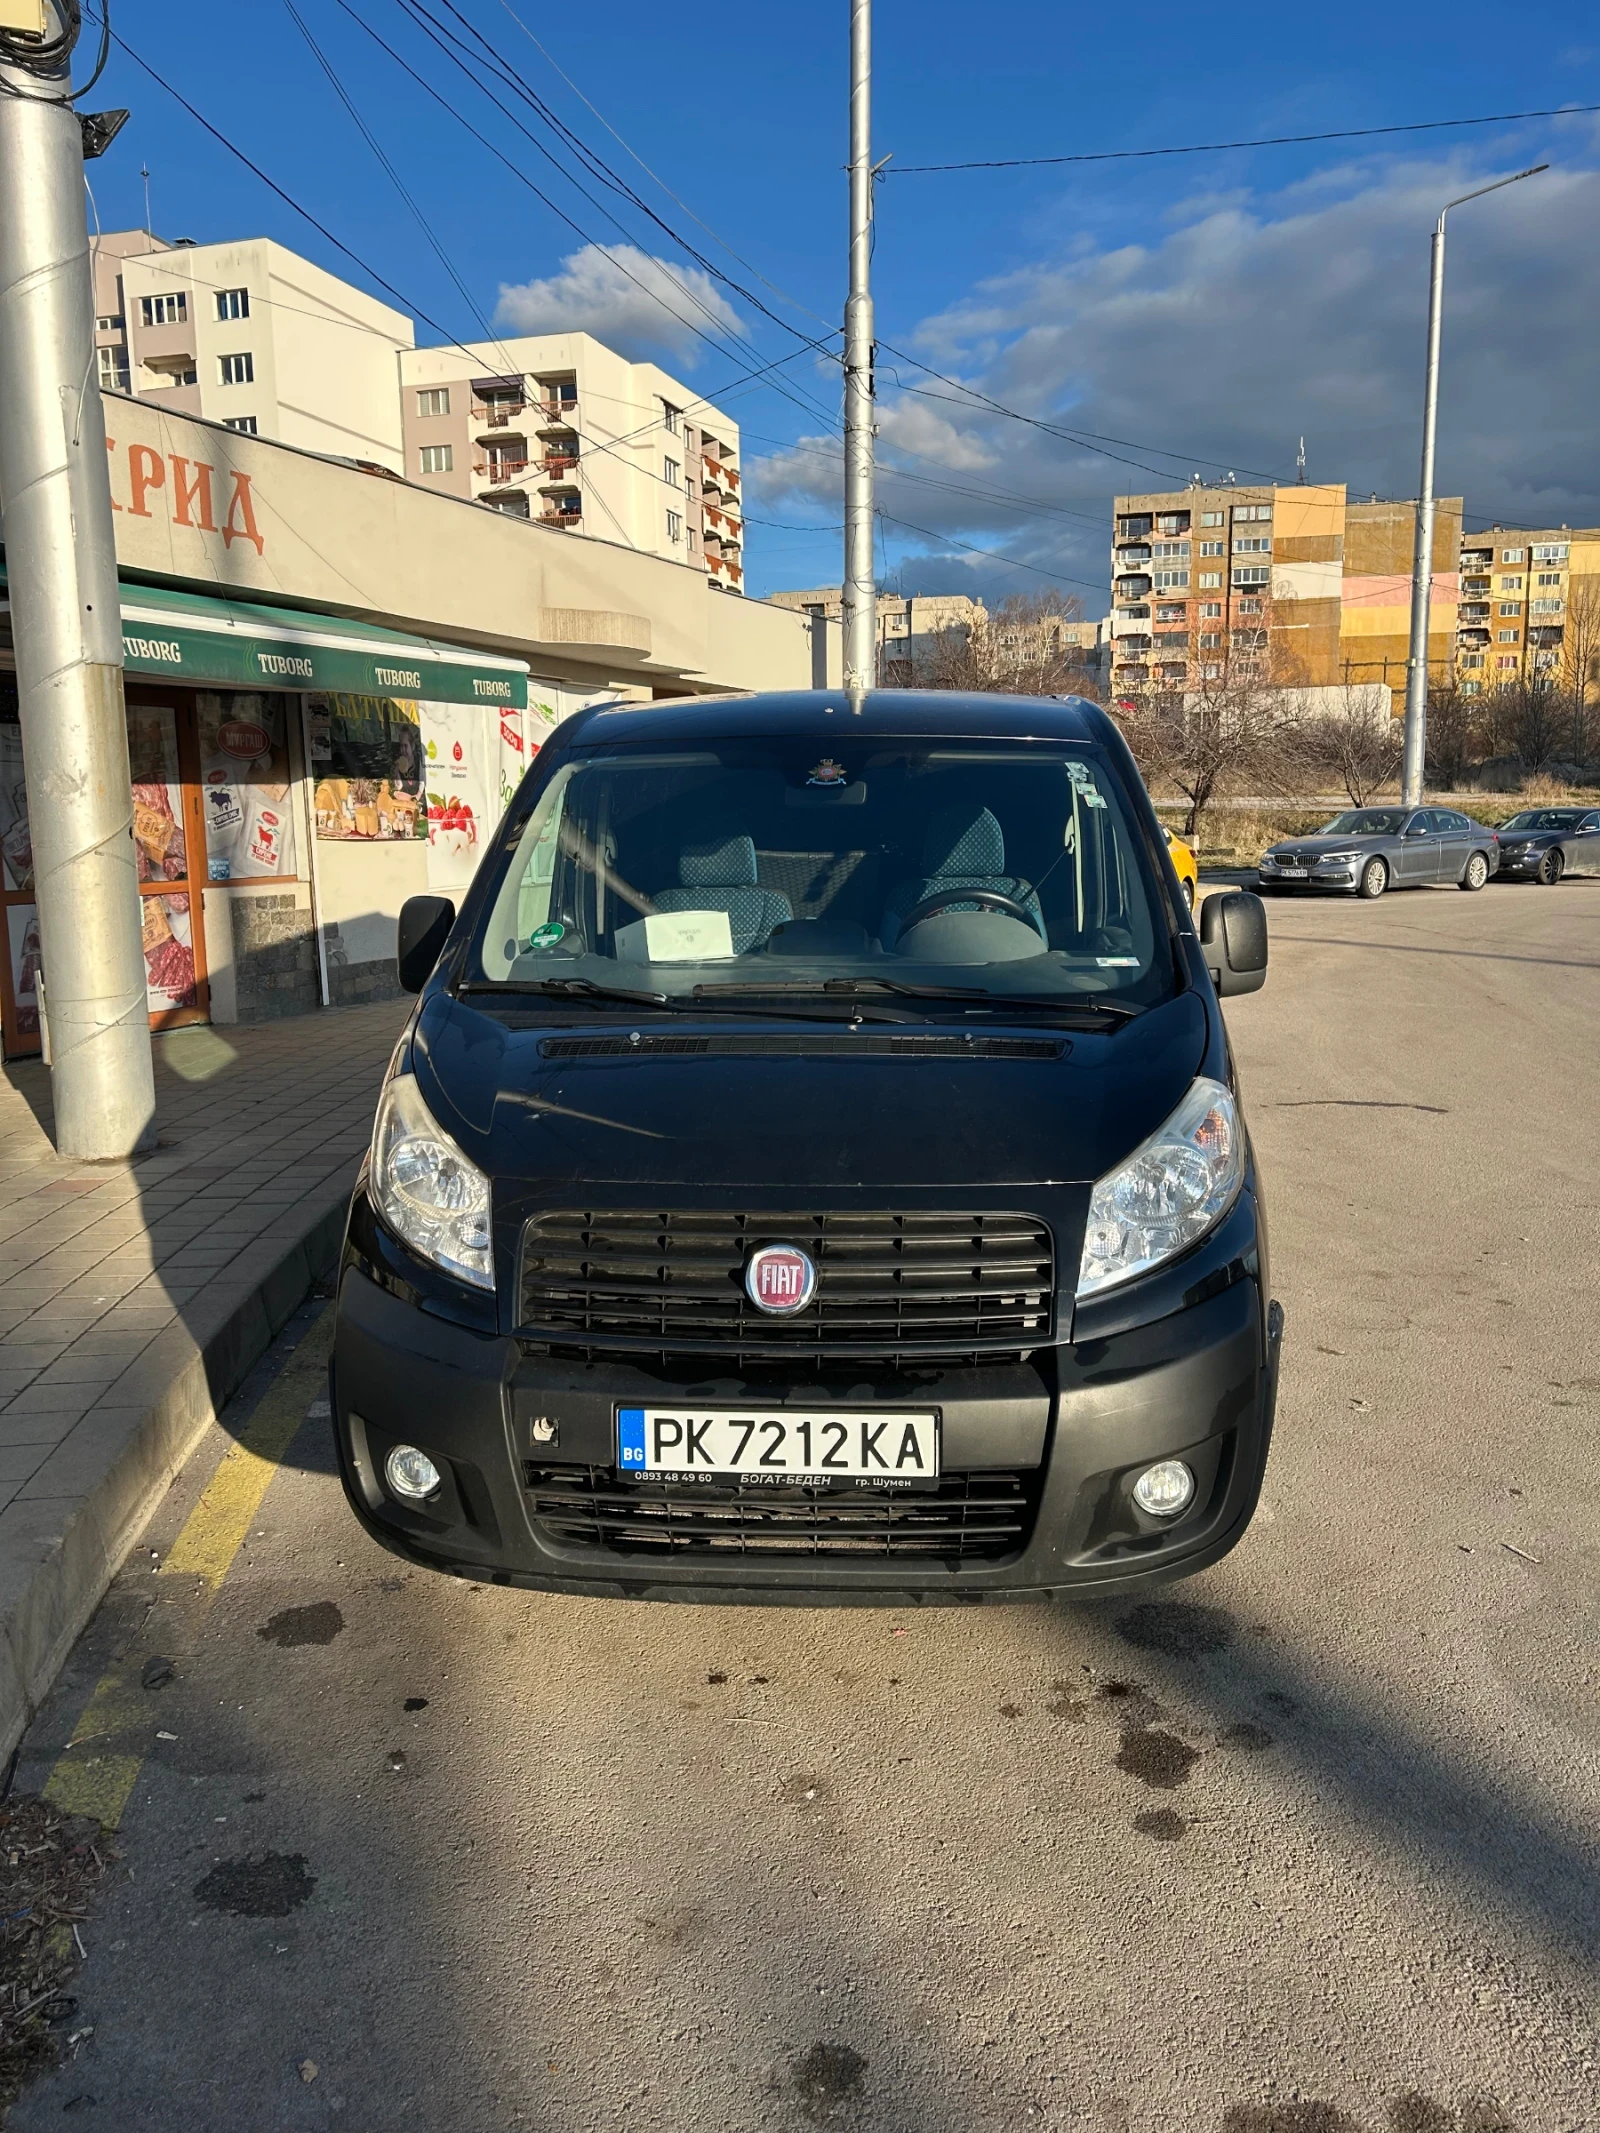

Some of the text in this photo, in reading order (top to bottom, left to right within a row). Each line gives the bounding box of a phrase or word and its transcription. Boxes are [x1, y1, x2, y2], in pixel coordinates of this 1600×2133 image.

[122, 635, 181, 663] TUBORG
[257, 653, 313, 678] TUBORG
[375, 666, 421, 690] TUBORG
[472, 678, 511, 698] TUBORG
[225, 731, 264, 748] МУРГАШ
[500, 768, 515, 802] За
[543, 923, 553, 935] 4
[761, 1264, 801, 1295] FIAT
[654, 1418, 924, 1469] PK 7212 KA
[623, 1447, 644, 1461] BG
[634, 1471, 712, 1483] 0893 48 49 60
[740, 1473, 832, 1486] БОГАТ-БЕДЕН
[855, 1477, 911, 1488] гр. Шумен
